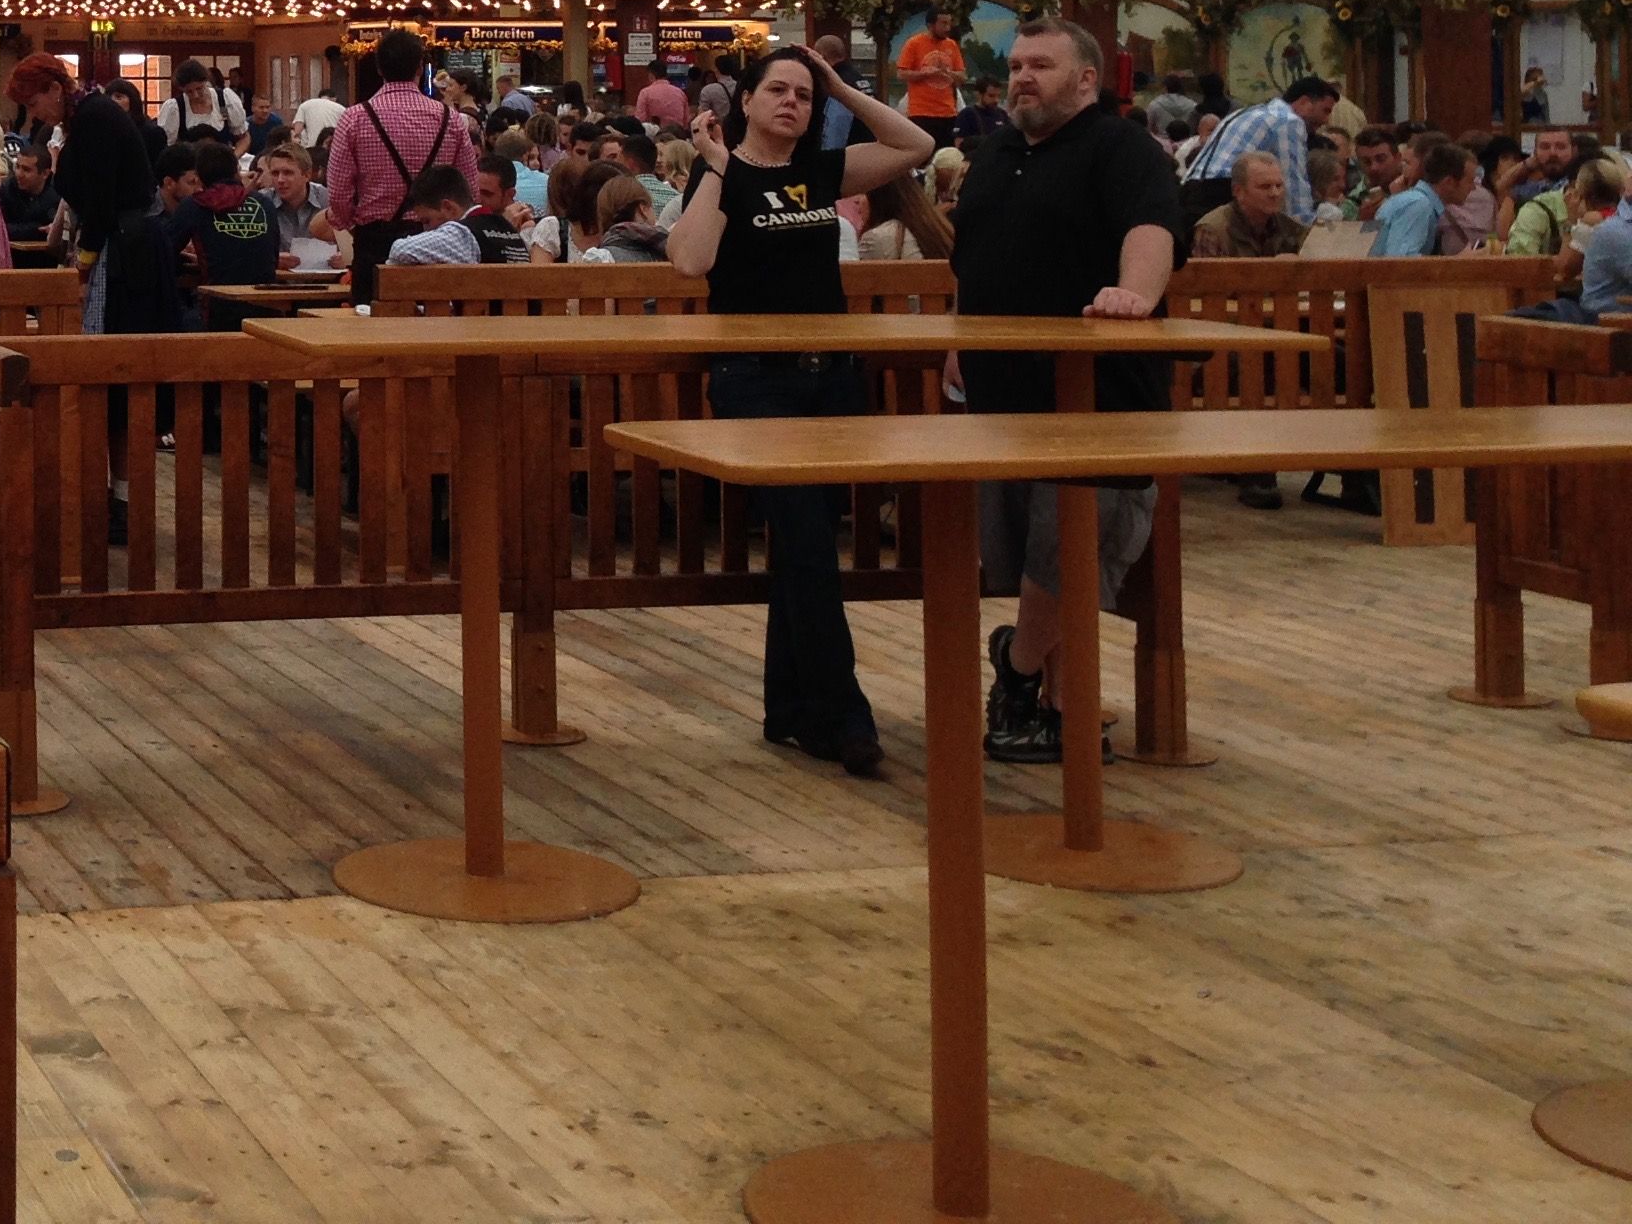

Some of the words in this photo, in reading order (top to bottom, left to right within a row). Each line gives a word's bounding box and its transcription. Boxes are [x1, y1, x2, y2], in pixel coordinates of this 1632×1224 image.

[471, 27, 536, 40] Brotzeiten
[660, 27, 703, 40] tzeiten
[763, 191, 785, 209] I
[752, 206, 838, 228] CANMORE
